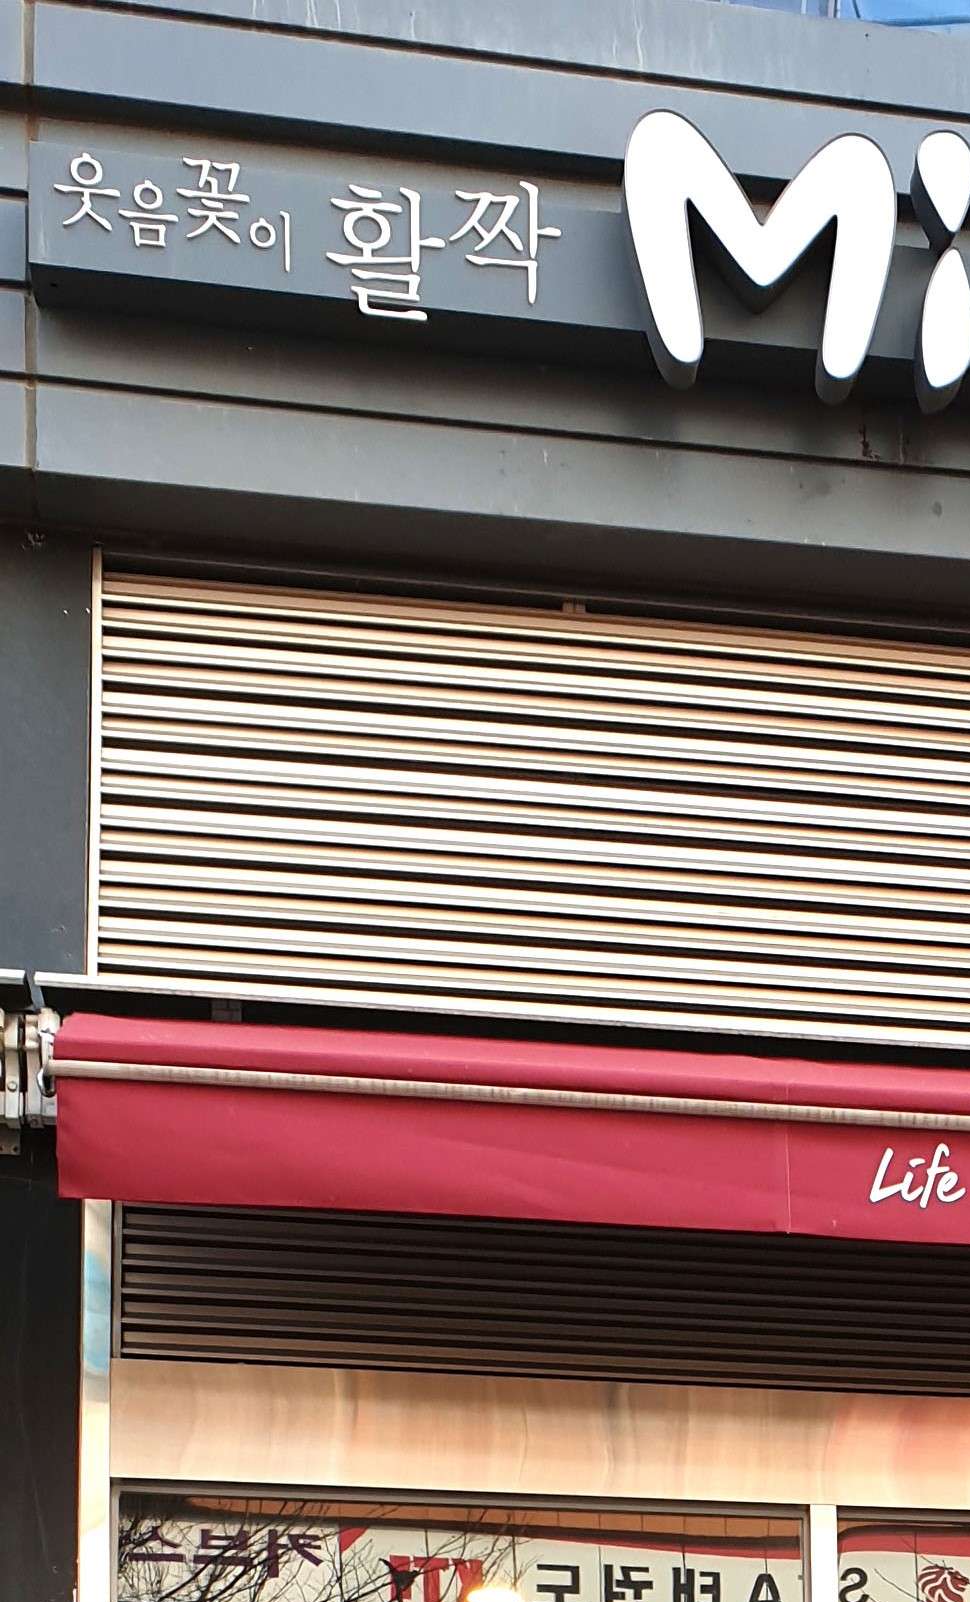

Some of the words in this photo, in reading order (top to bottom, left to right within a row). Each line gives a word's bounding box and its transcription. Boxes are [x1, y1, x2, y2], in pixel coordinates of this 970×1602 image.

[53, 151, 293, 273] 웃음꽃이
[326, 179, 563, 322] 활짝
[868, 1143, 967, 1209] Life
